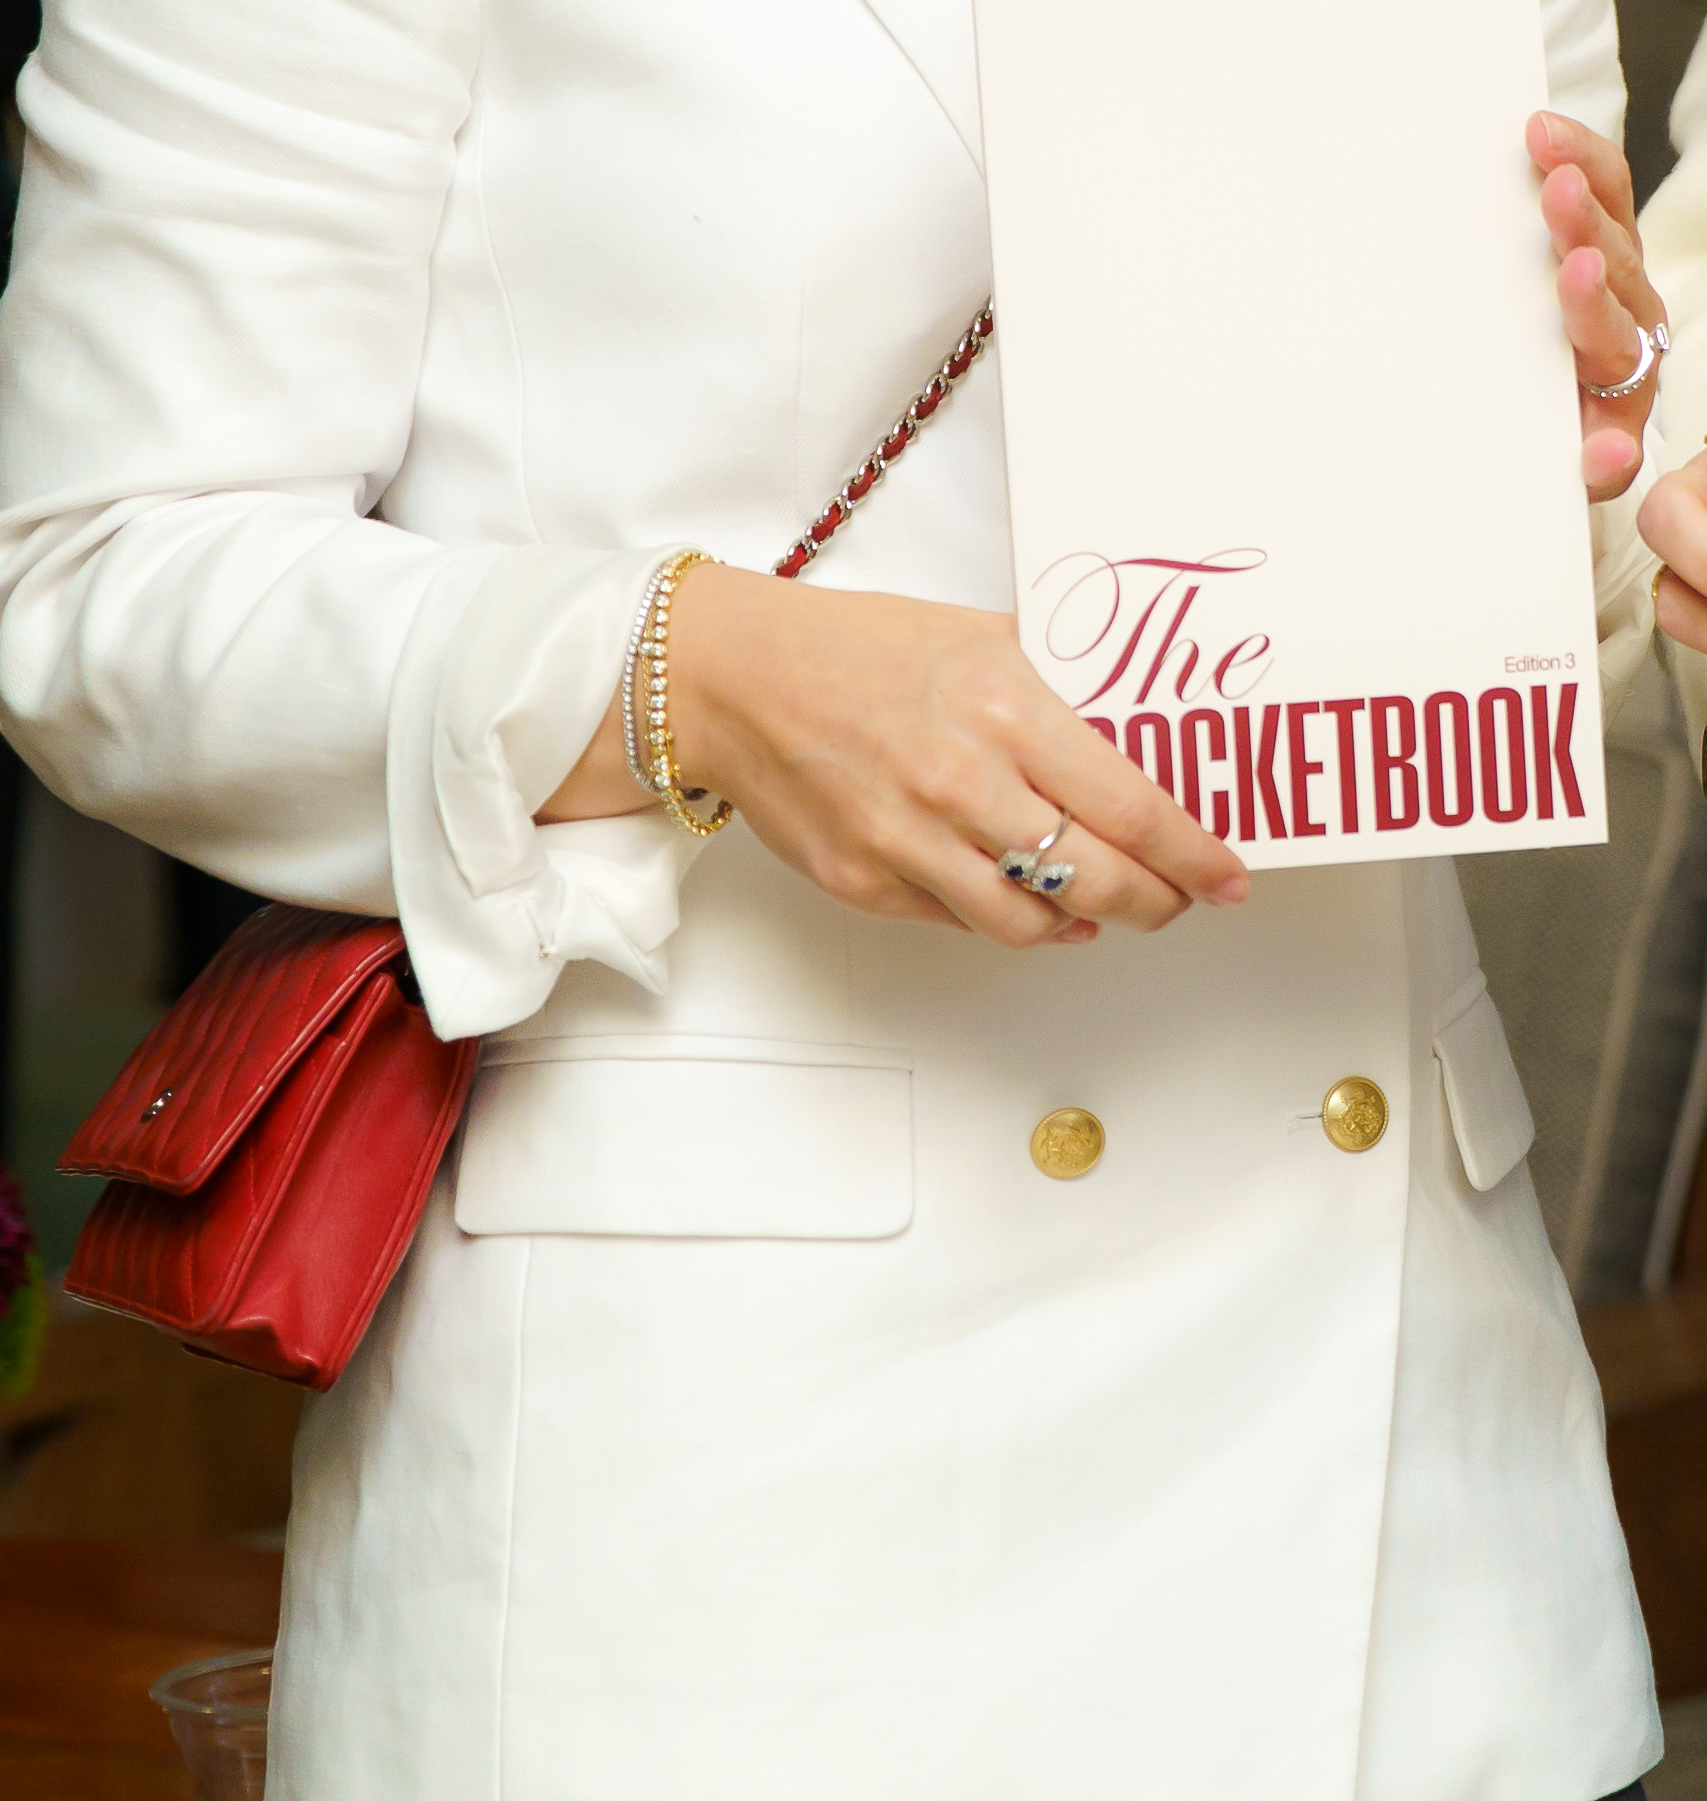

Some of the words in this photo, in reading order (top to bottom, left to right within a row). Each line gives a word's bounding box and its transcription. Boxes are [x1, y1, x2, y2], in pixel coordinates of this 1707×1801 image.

[1030, 547, 1275, 711] The
[1504, 655, 1560, 674] Edition
[1564, 652, 1576, 670] 3
[1081, 682, 1586, 842] OCKETBOOK
